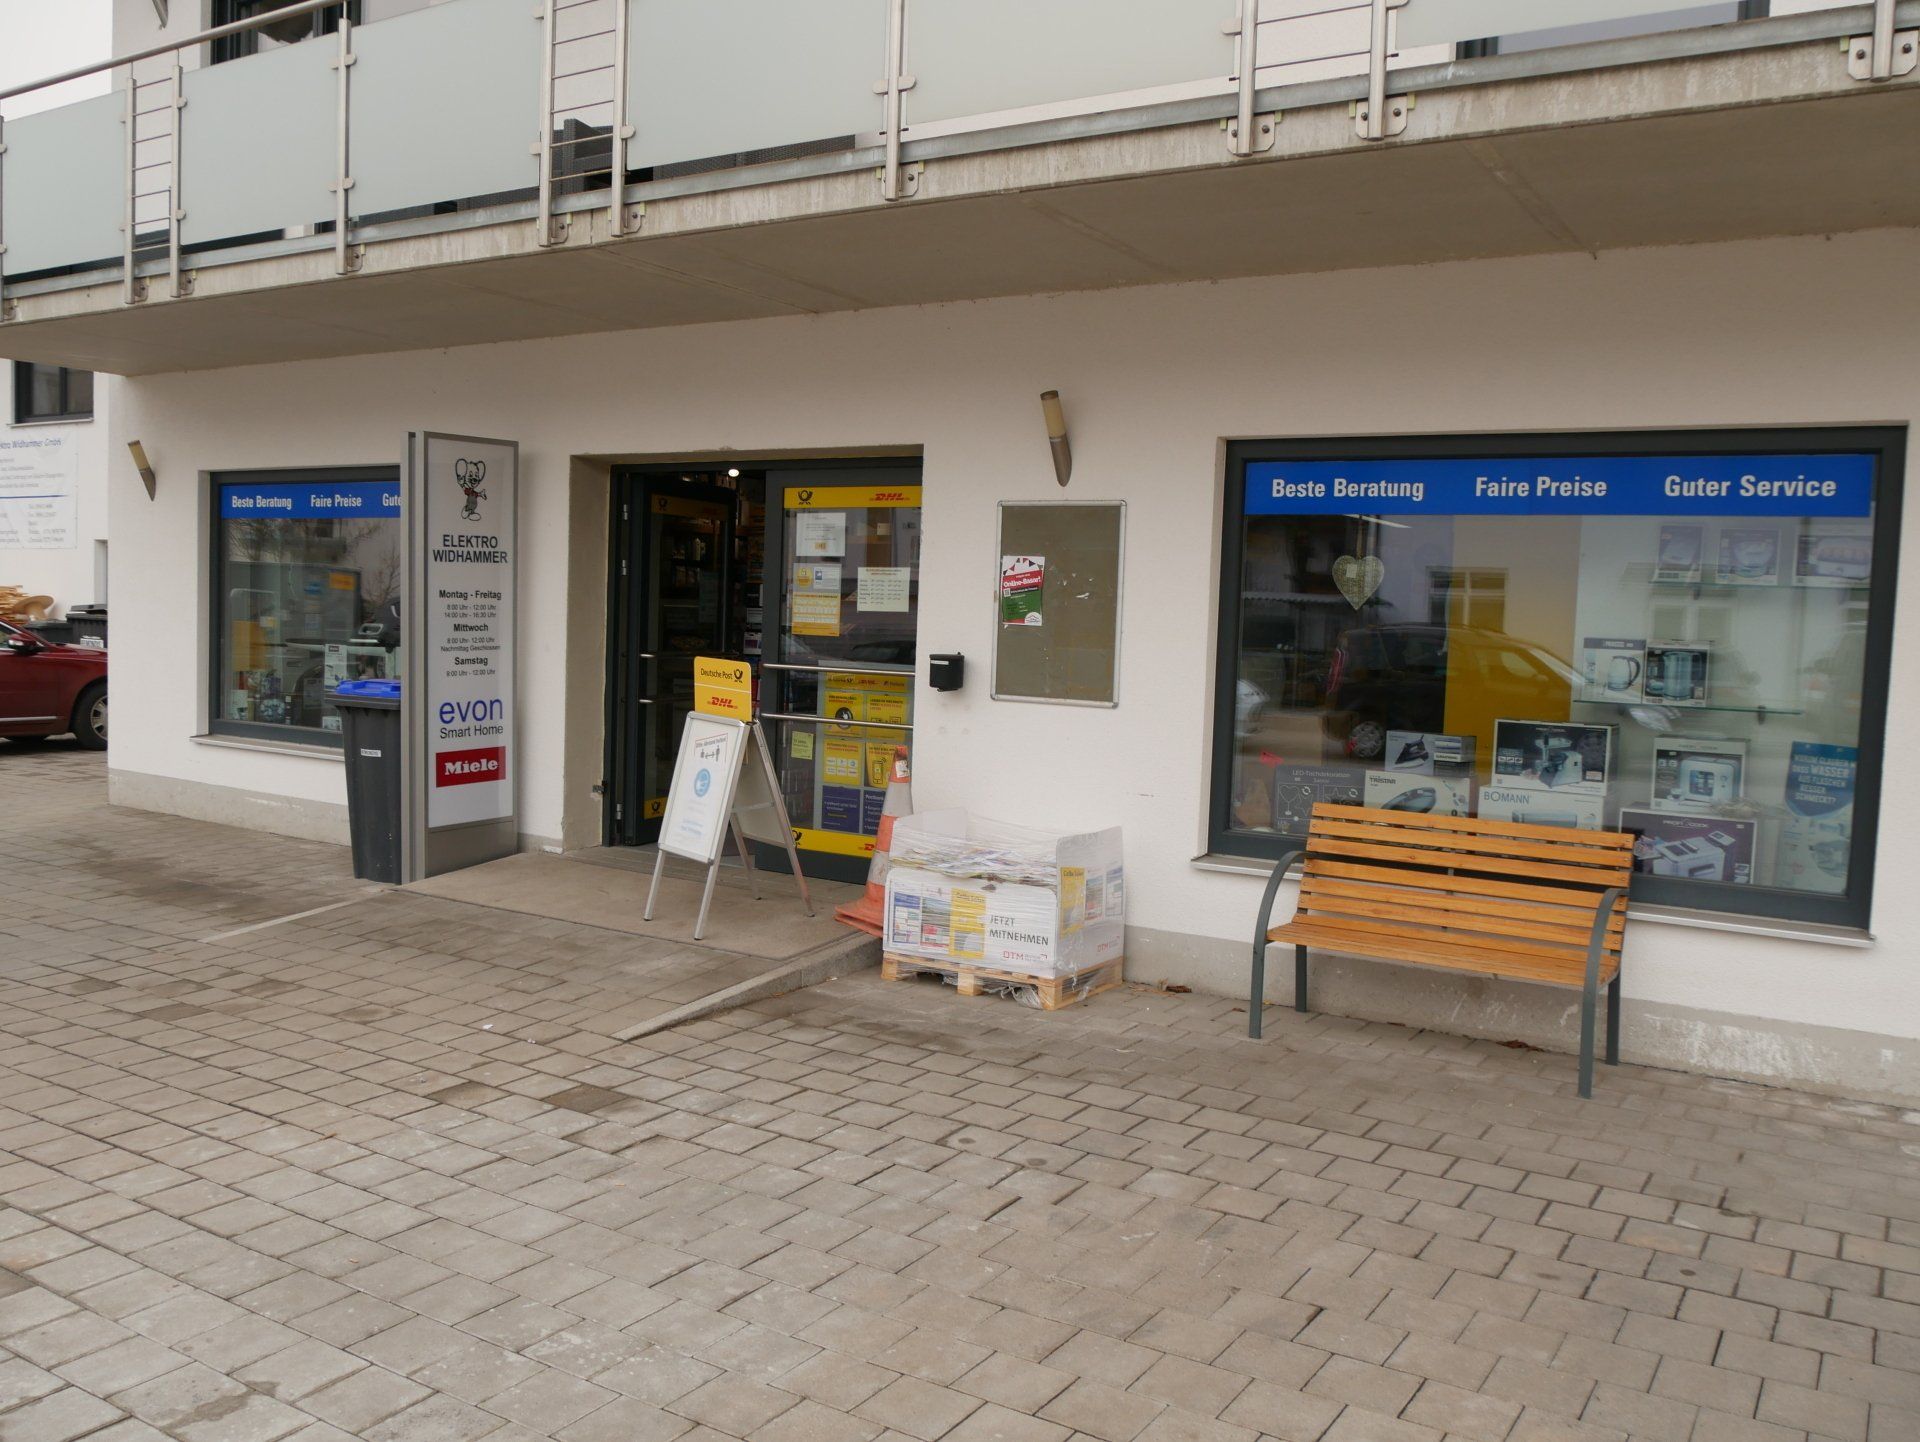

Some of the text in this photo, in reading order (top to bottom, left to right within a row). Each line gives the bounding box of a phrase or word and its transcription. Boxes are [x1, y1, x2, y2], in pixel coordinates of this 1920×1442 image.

[1271, 477, 1425, 502] Beste Beratung
[1475, 475, 1608, 497] Faire Preise
[1664, 474, 1837, 497] Guter Service
[231, 495, 292, 511] Beste Beratung
[310, 493, 362, 508] Faire Preise
[382, 493, 402, 507] Gute
[874, 492, 905, 502] DHL
[442, 534, 499, 549] ELEKTRO
[432, 549, 508, 564] WIDHAMMER
[438, 589, 468, 601] Montag
[475, 590, 502, 601] Freitag
[453, 623, 489, 632] Mittwoch
[454, 656, 489, 666] Samstag
[700, 668, 733, 680] Deutsche Post
[711, 696, 734, 708] DHL
[439, 698, 503, 724] evon
[440, 724, 504, 739] Smart Home
[444, 758, 500, 776] Miele
[1810, 764, 1850, 778] WASSER
[1369, 777, 1396, 785] TRISTAR
[1483, 791, 1530, 805] BOMANN
[990, 914, 1015, 926] JETZT
[989, 928, 1049, 946] MITNEHMEN
